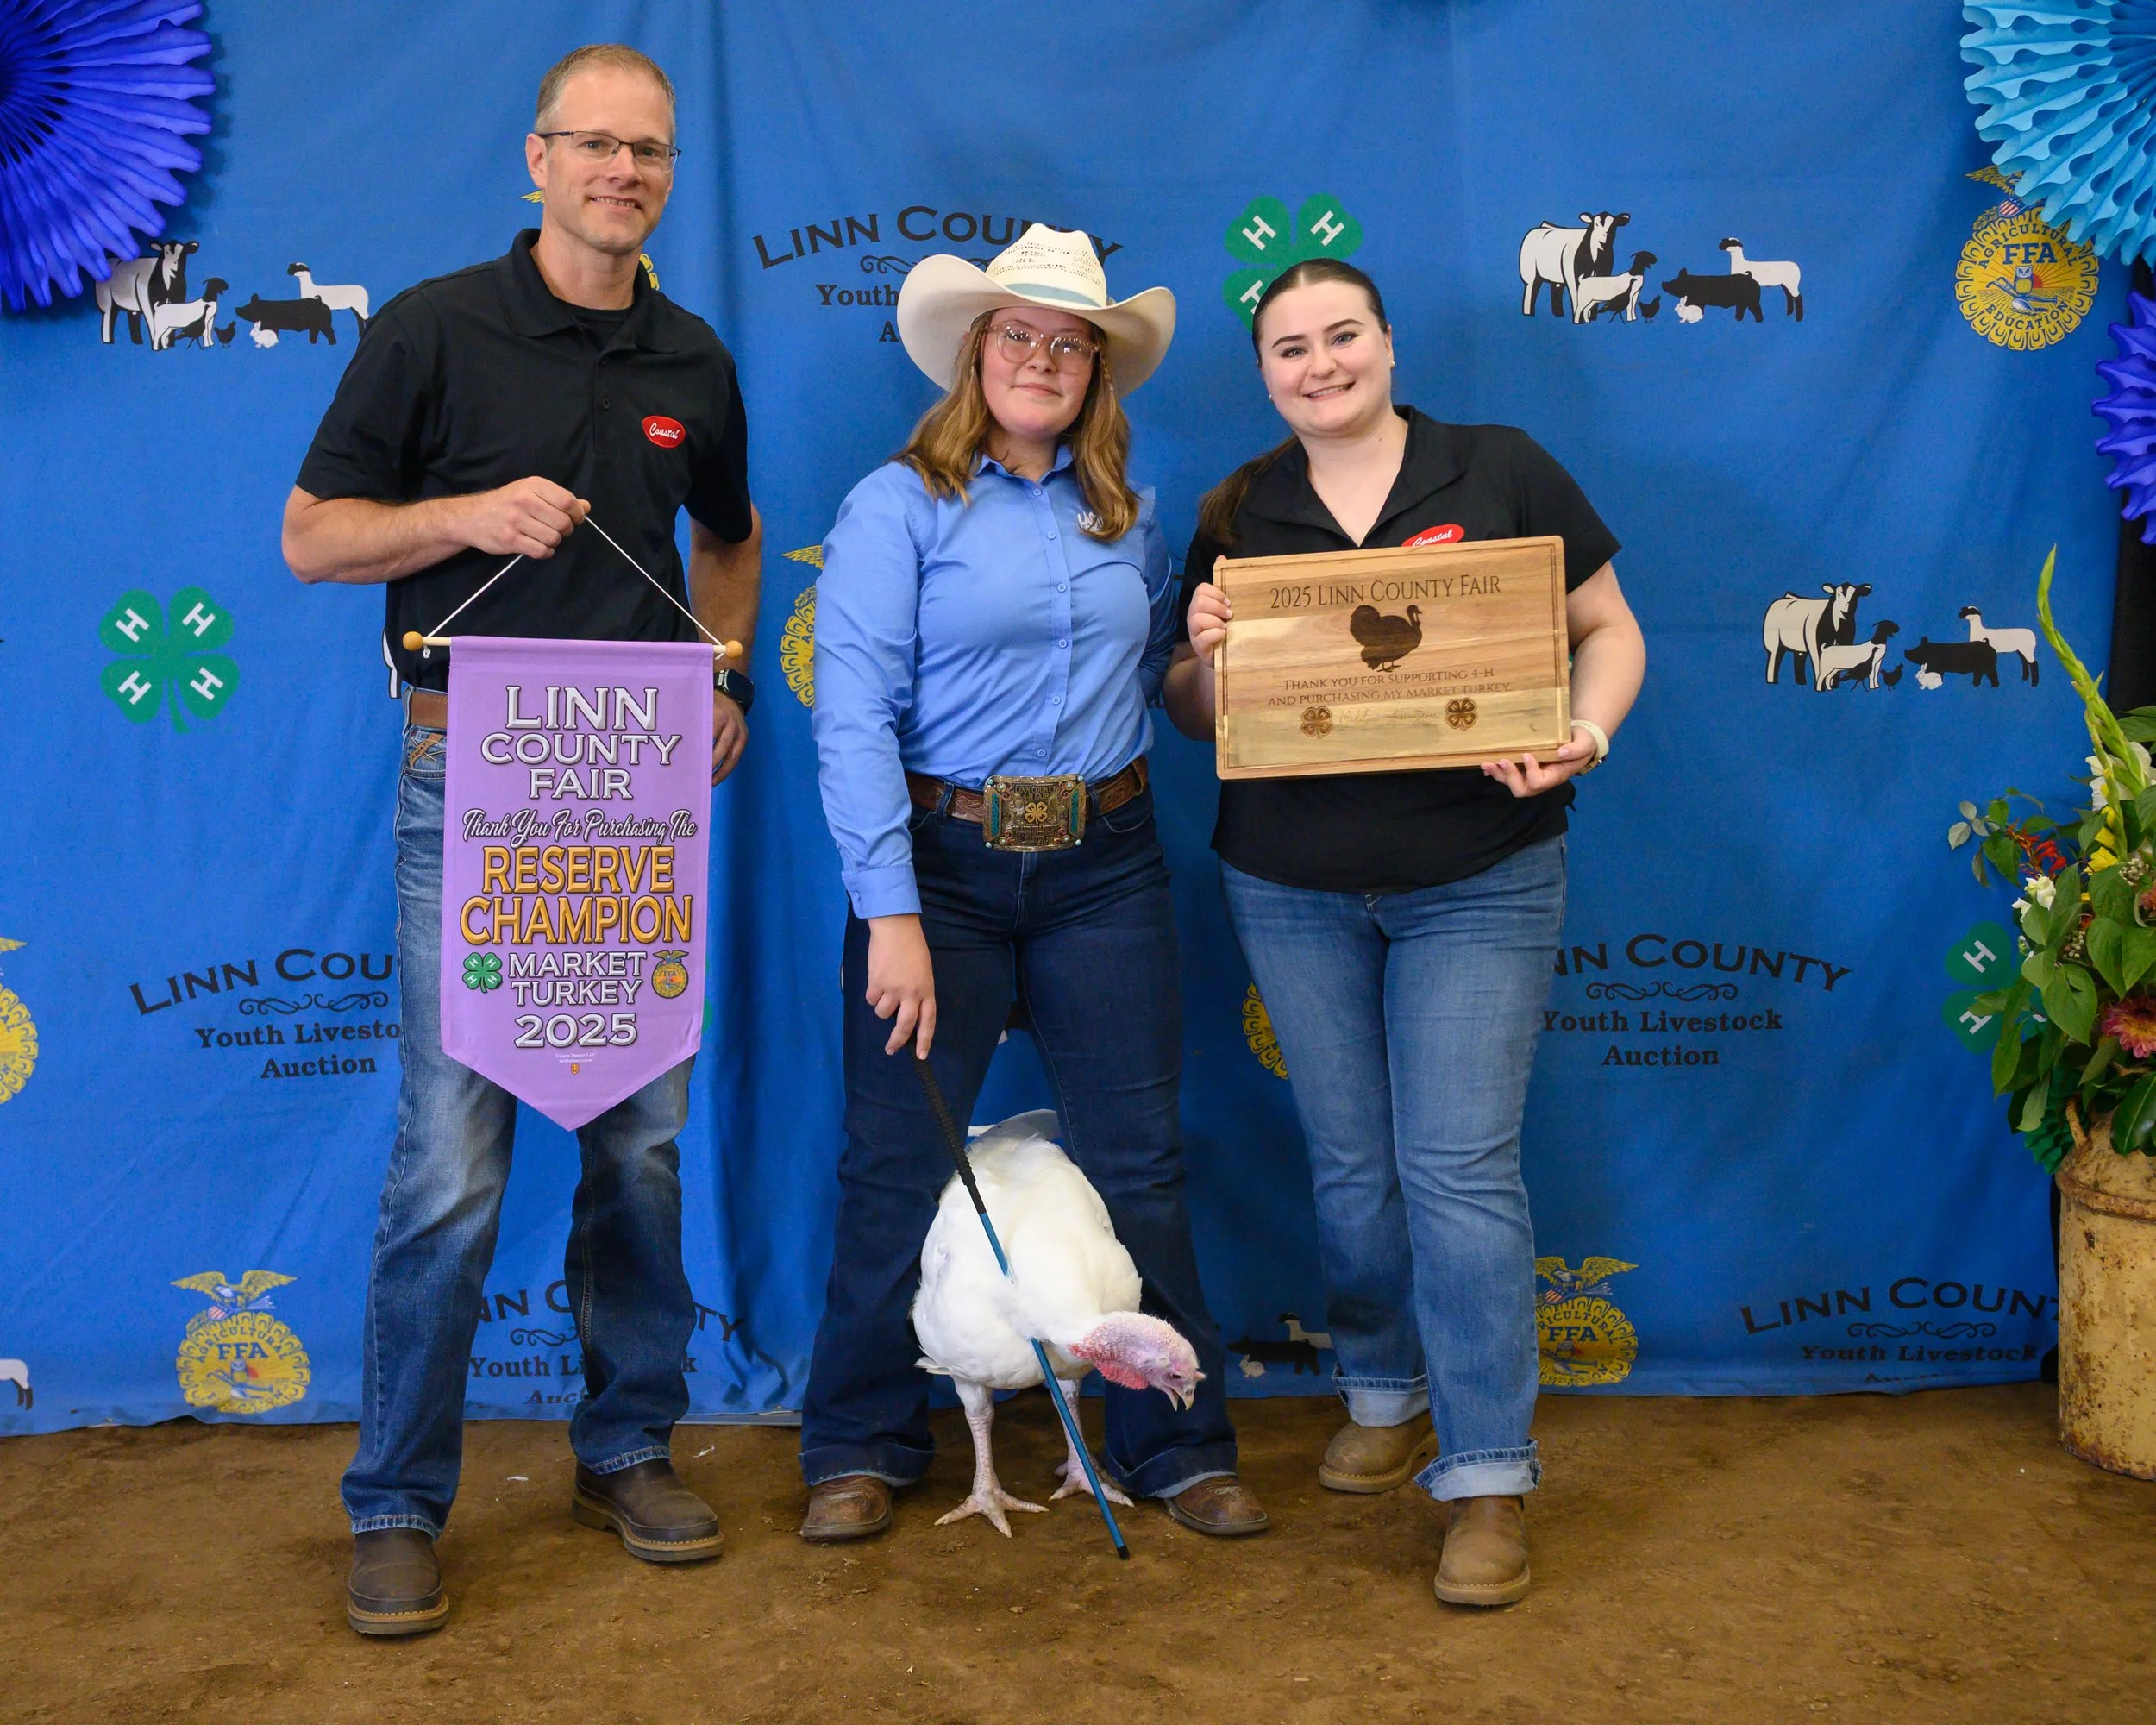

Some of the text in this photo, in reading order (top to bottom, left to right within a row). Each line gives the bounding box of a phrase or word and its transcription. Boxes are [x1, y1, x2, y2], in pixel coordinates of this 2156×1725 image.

[753, 205, 1124, 270] LINN COUY
[1242, 210, 1345, 251] H H
[1978, 223, 2078, 270] AGRICULTURAL
[2002, 242, 2058, 266] FFA
[1984, 299, 2070, 330] EDUCATION
[649, 423, 680, 439] Coastal
[1411, 529, 1452, 547] Coastal
[1269, 574, 1502, 609] 2025 LINN COUNTY FAIR
[115, 602, 216, 643] H H
[117, 667, 224, 705] H H
[1268, 694, 1296, 707] AND
[1300, 689, 1381, 706] PURCHASING
[1383, 688, 1402, 700] MY
[1407, 684, 1457, 699] MARKET
[1283, 667, 1495, 691] THANK YOU FOR SUPPORTING 4-H
[505, 686, 658, 731] LINN
[480, 732, 683, 766] COUNTY
[529, 767, 634, 800] FAIR
[462, 807, 698, 849] Thank You For Purchasing The
[482, 845, 675, 894] RESERVE
[460, 894, 693, 945] CHAMPION
[508, 950, 648, 978] MARKET
[1626, 933, 1853, 992] COUNTY
[1962, 939, 1997, 974] H
[129, 948, 393, 1016] LINN COU
[511, 979, 643, 1007] TURKEY
[194, 1019, 402, 1049] Youth Livesto
[513, 1013, 638, 1048] 2025
[1544, 1008, 1783, 1032] Youth Livestock
[260, 1054, 377, 1079] Auction
[1601, 1044, 1720, 1067] Auction
[1740, 1276, 2059, 1335] LINN COUN
[1538, 1310, 1620, 1345] RICULTURAL
[1546, 1325, 1599, 1343] FFA
[216, 1341, 269, 1360] FFA
[470, 1355, 551, 1378] Youth
[1801, 1344, 2038, 1363] Youth Livestock
